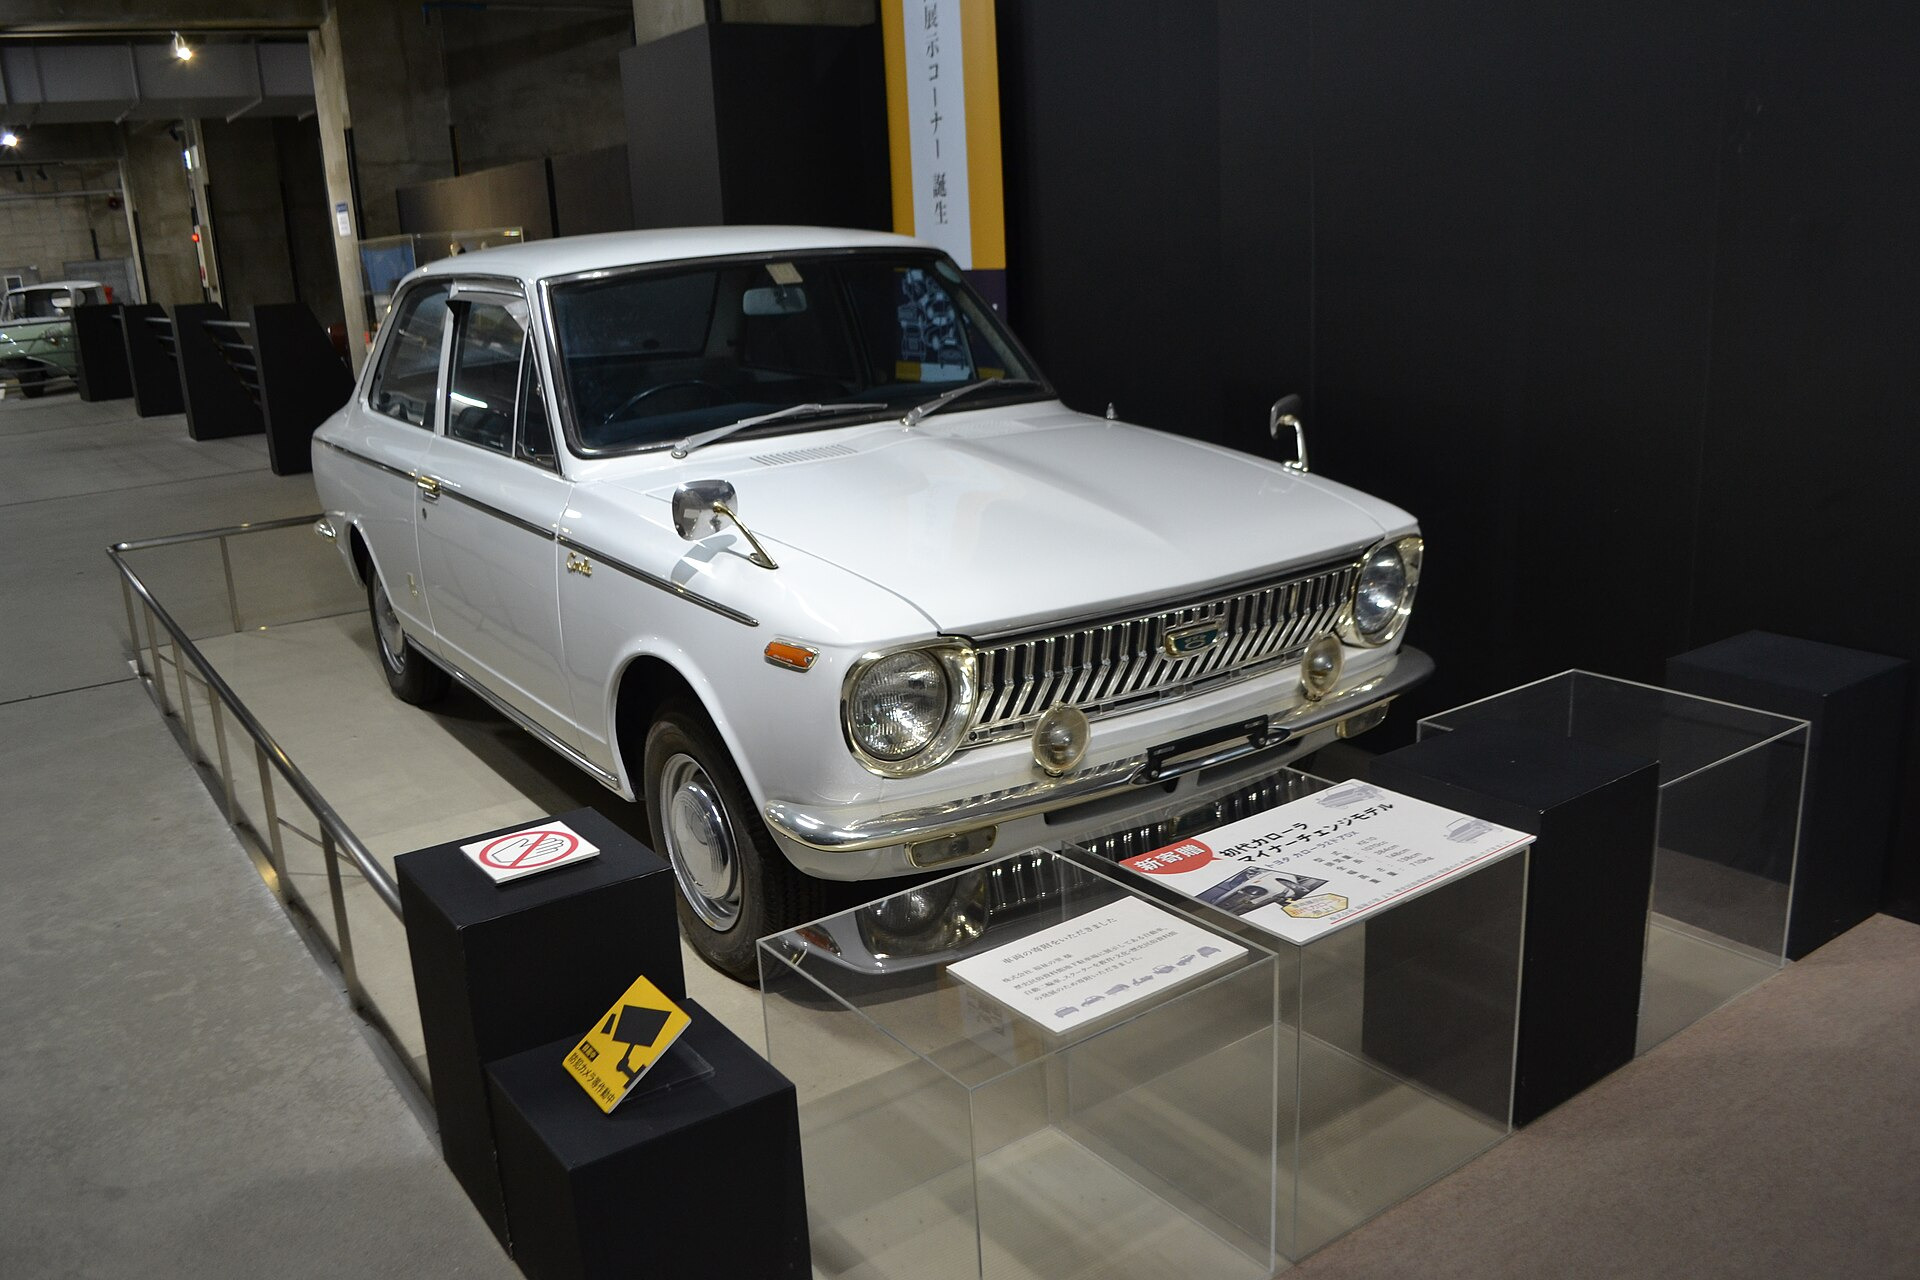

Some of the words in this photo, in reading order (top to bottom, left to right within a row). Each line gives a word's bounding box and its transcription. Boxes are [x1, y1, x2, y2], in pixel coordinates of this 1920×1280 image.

[923, 0, 943, 159] 展示コーナー
[932, 172, 948, 225] 誕生
[1132, 843, 1206, 872] 新寄贈
[1219, 821, 1310, 857] 初代カローラ
[1236, 801, 1394, 863] マイナーチェンジモデル
